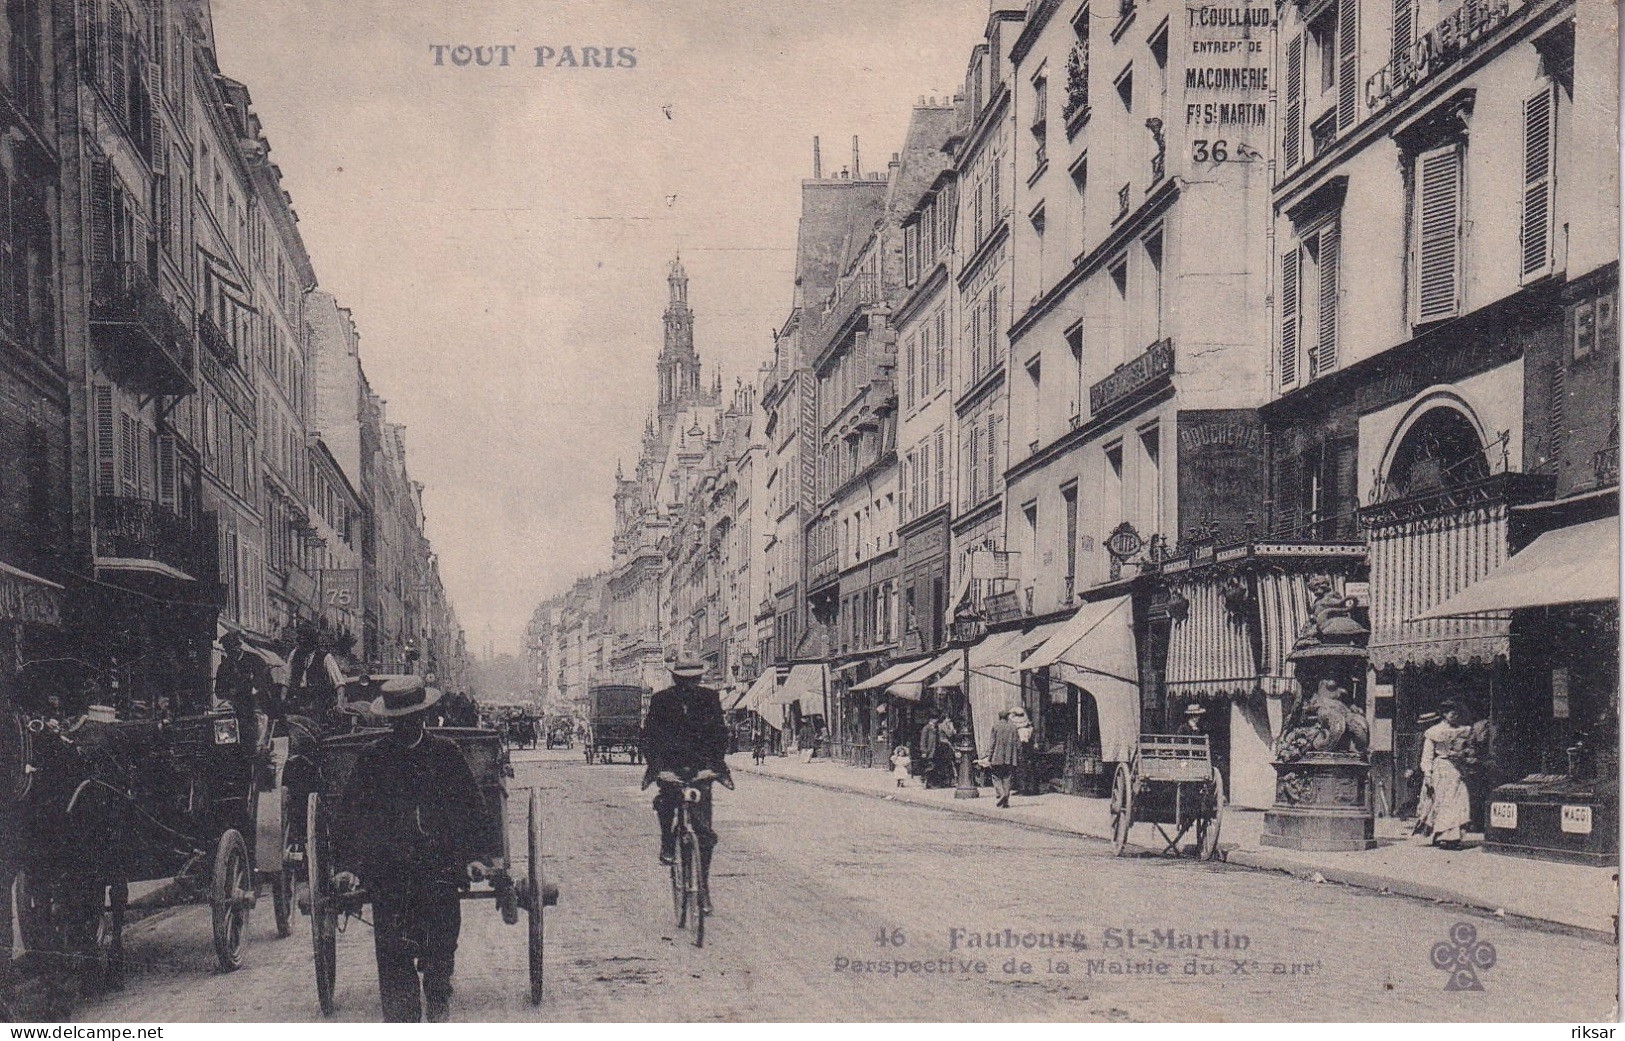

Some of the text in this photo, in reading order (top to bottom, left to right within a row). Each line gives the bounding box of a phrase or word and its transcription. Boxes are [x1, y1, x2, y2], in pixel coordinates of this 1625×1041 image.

[1248, 41, 1263, 52] DE
[1220, 103, 1267, 126] MARTIN
[1193, 139, 1228, 163] 36
[801, 450, 815, 515] MAISON
[326, 588, 352, 606] 75
